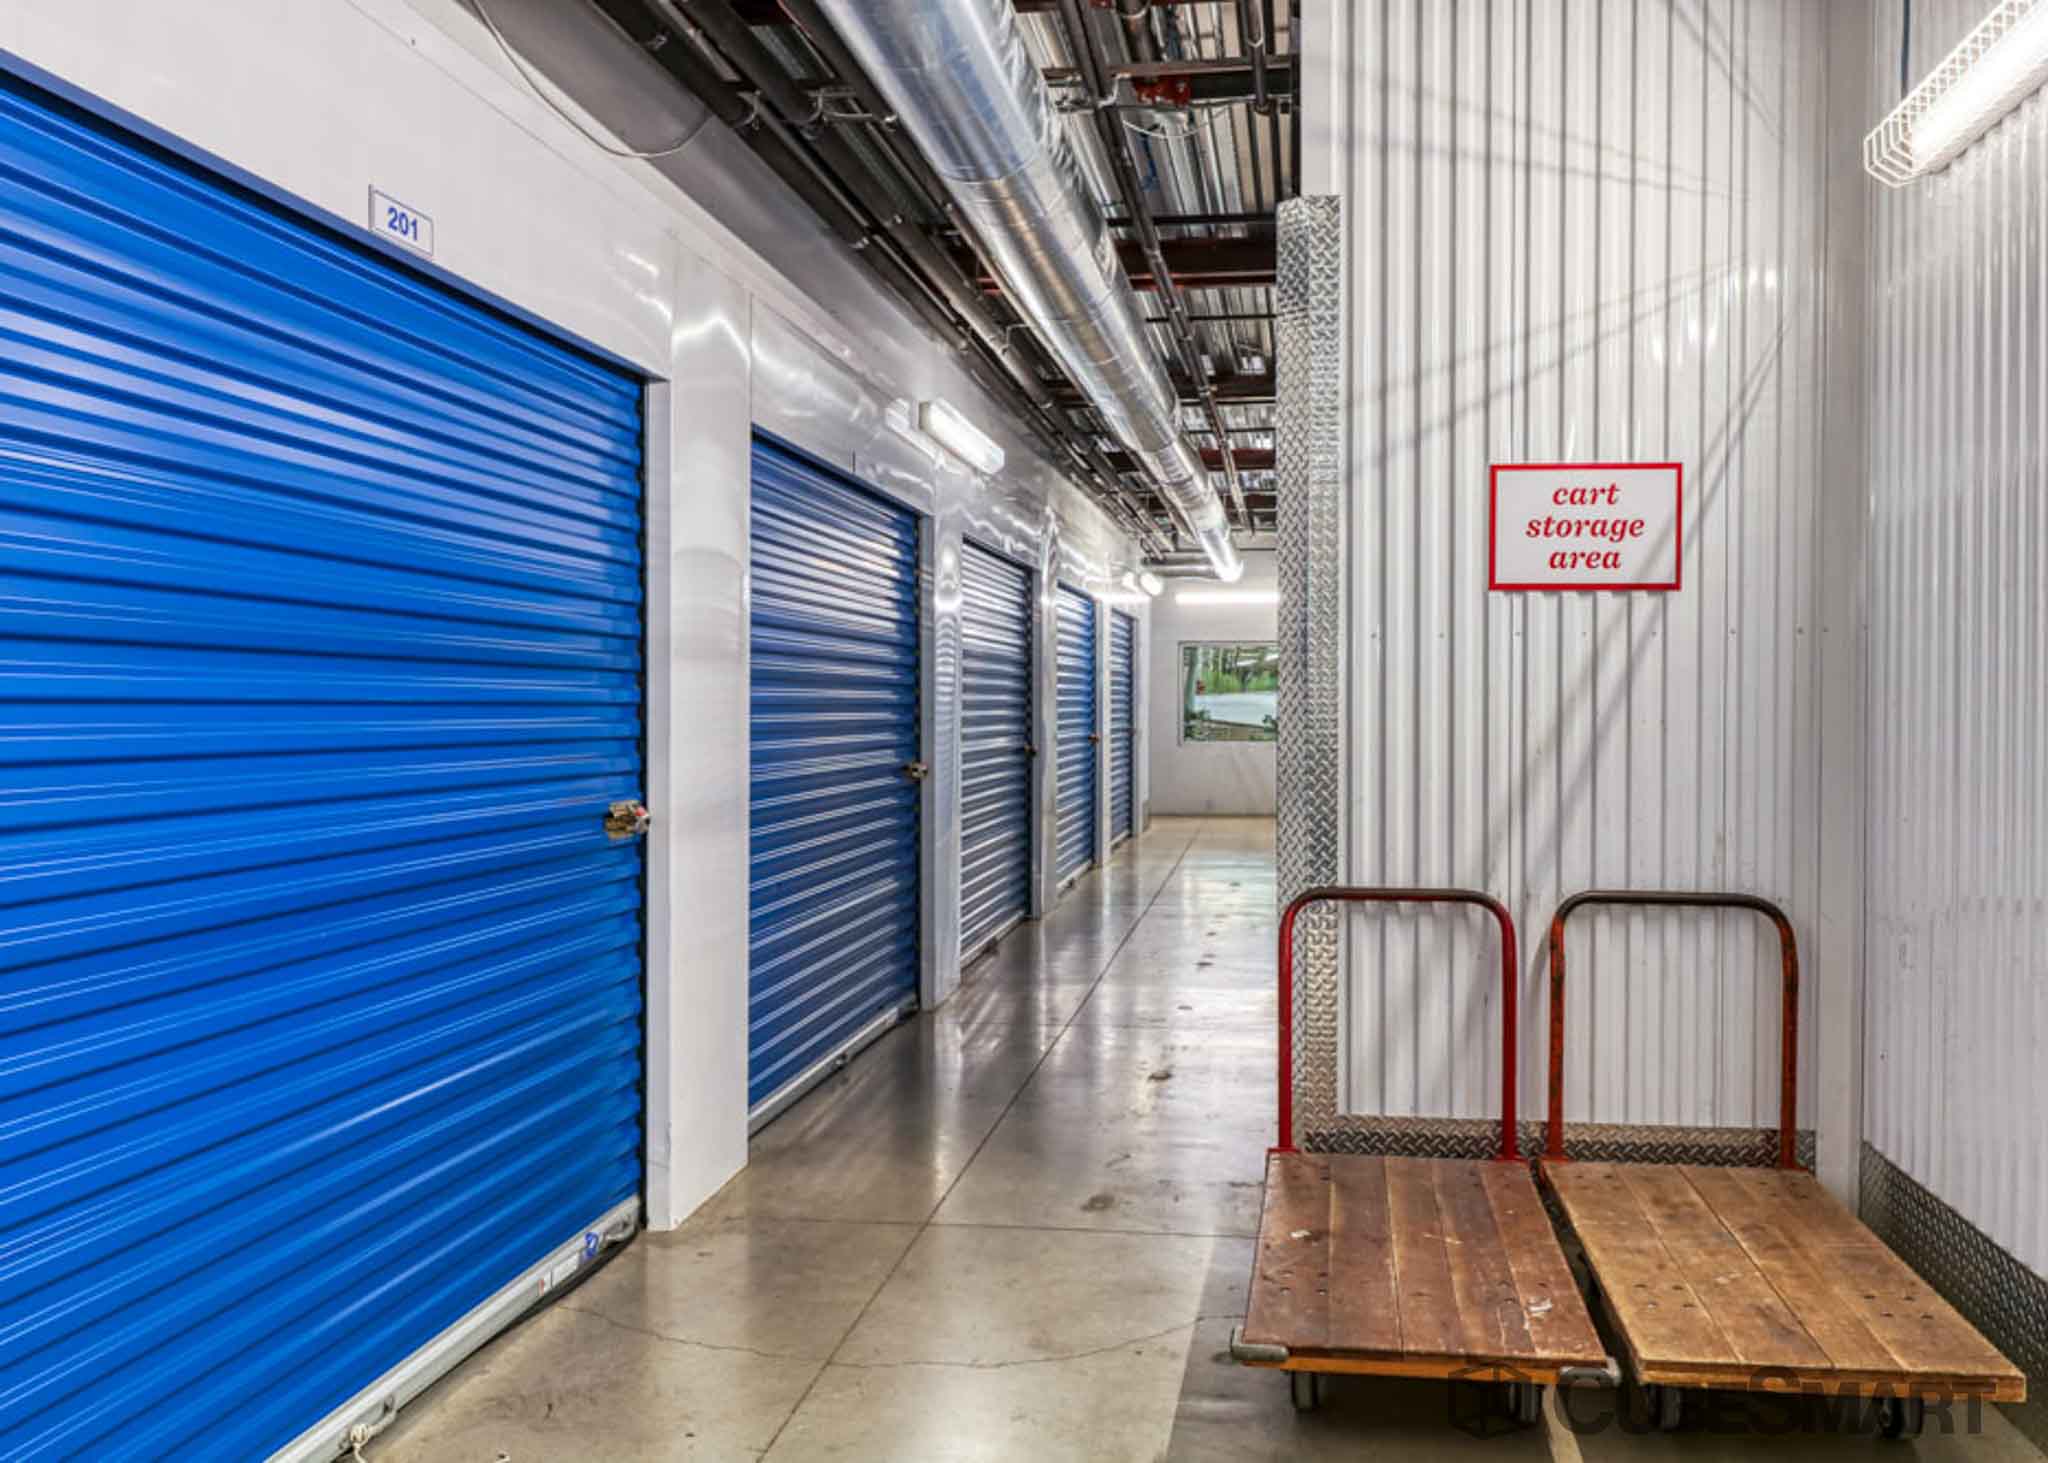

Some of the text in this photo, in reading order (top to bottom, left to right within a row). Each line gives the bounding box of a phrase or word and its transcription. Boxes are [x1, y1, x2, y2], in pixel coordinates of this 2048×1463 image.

[387, 206, 418, 241] 201
[1552, 483, 1620, 506] cart
[1525, 515, 1645, 543] storage
[1548, 550, 1621, 570] area
